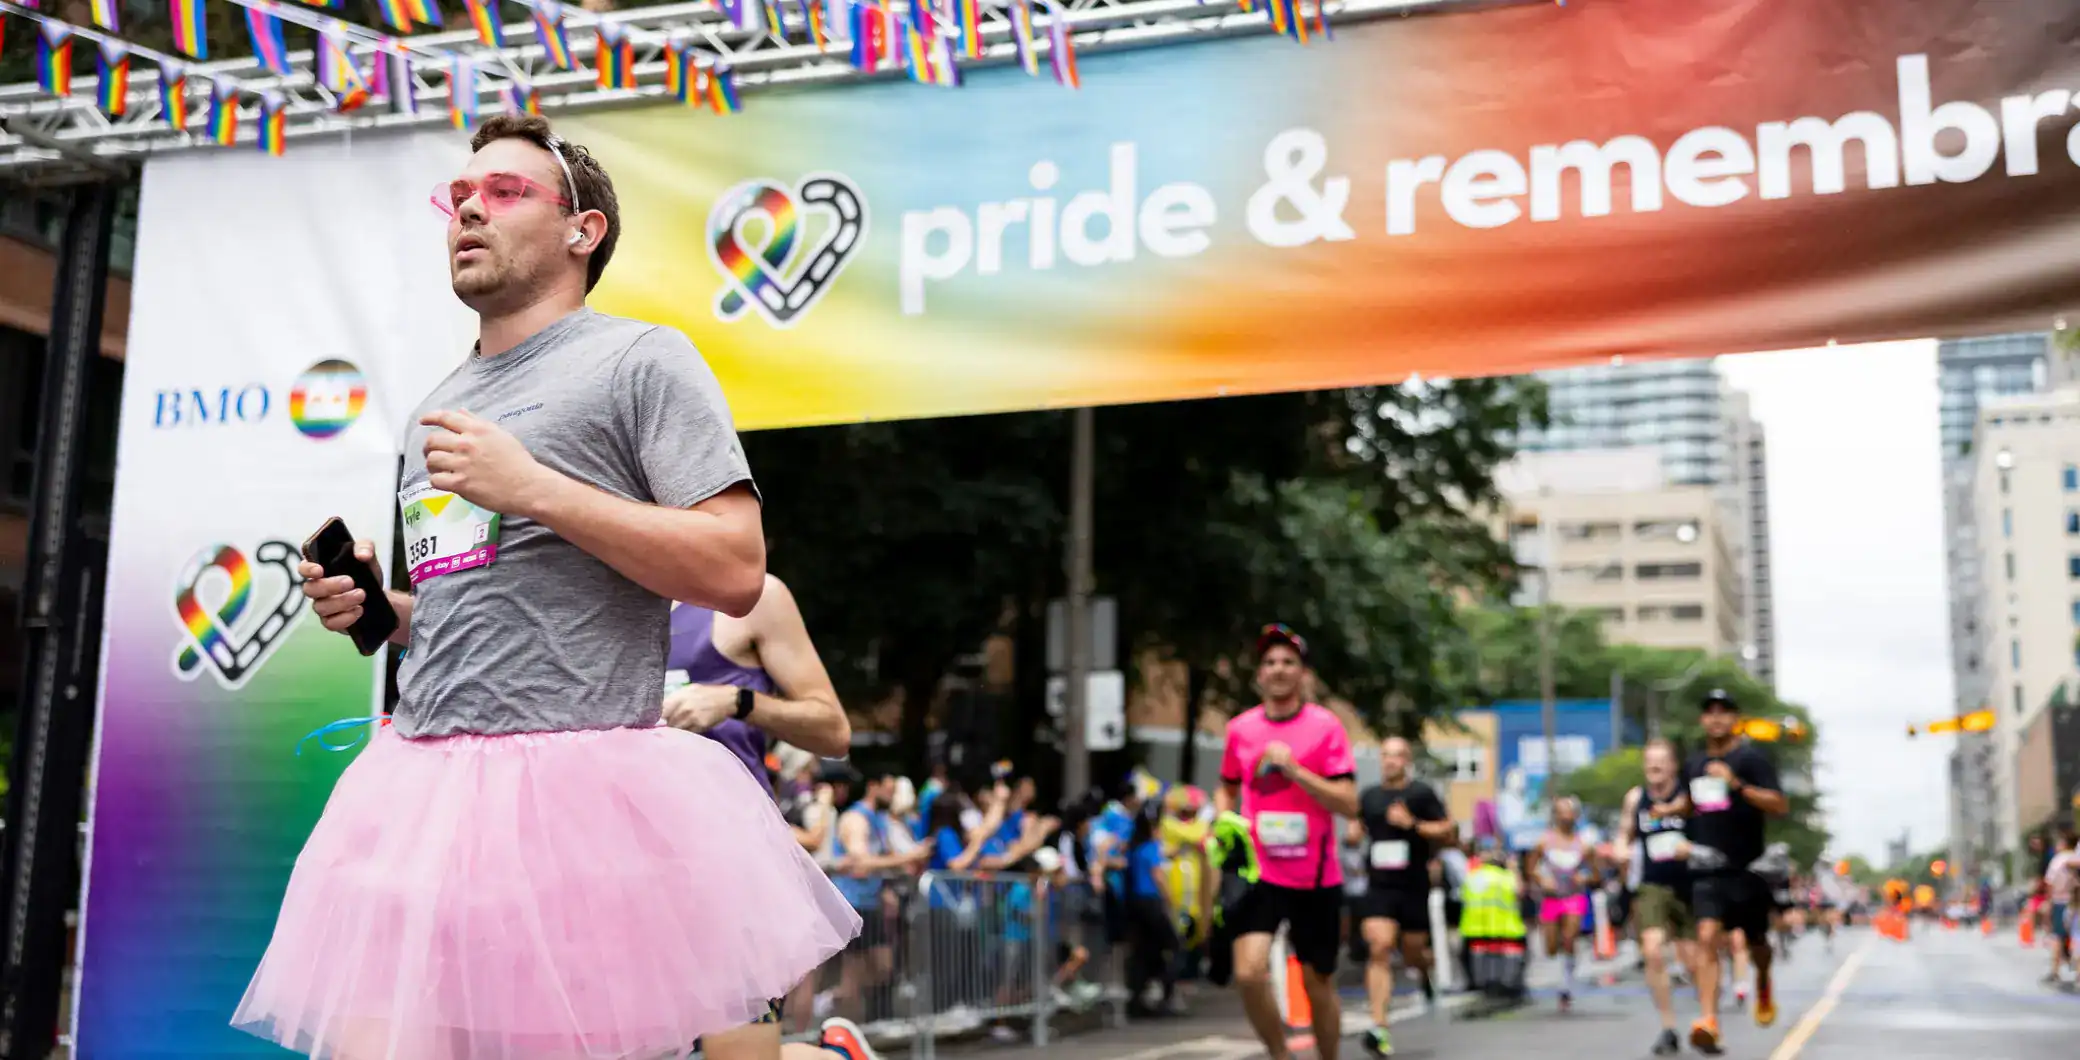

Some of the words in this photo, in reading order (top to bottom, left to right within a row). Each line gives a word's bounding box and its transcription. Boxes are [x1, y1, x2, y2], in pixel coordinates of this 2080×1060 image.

[899, 140, 1218, 315] pride
[1244, 127, 1356, 248] &
[1386, 53, 2080, 236] remembr
[152, 383, 270, 428] BMO
[409, 535, 437, 565] 3581
